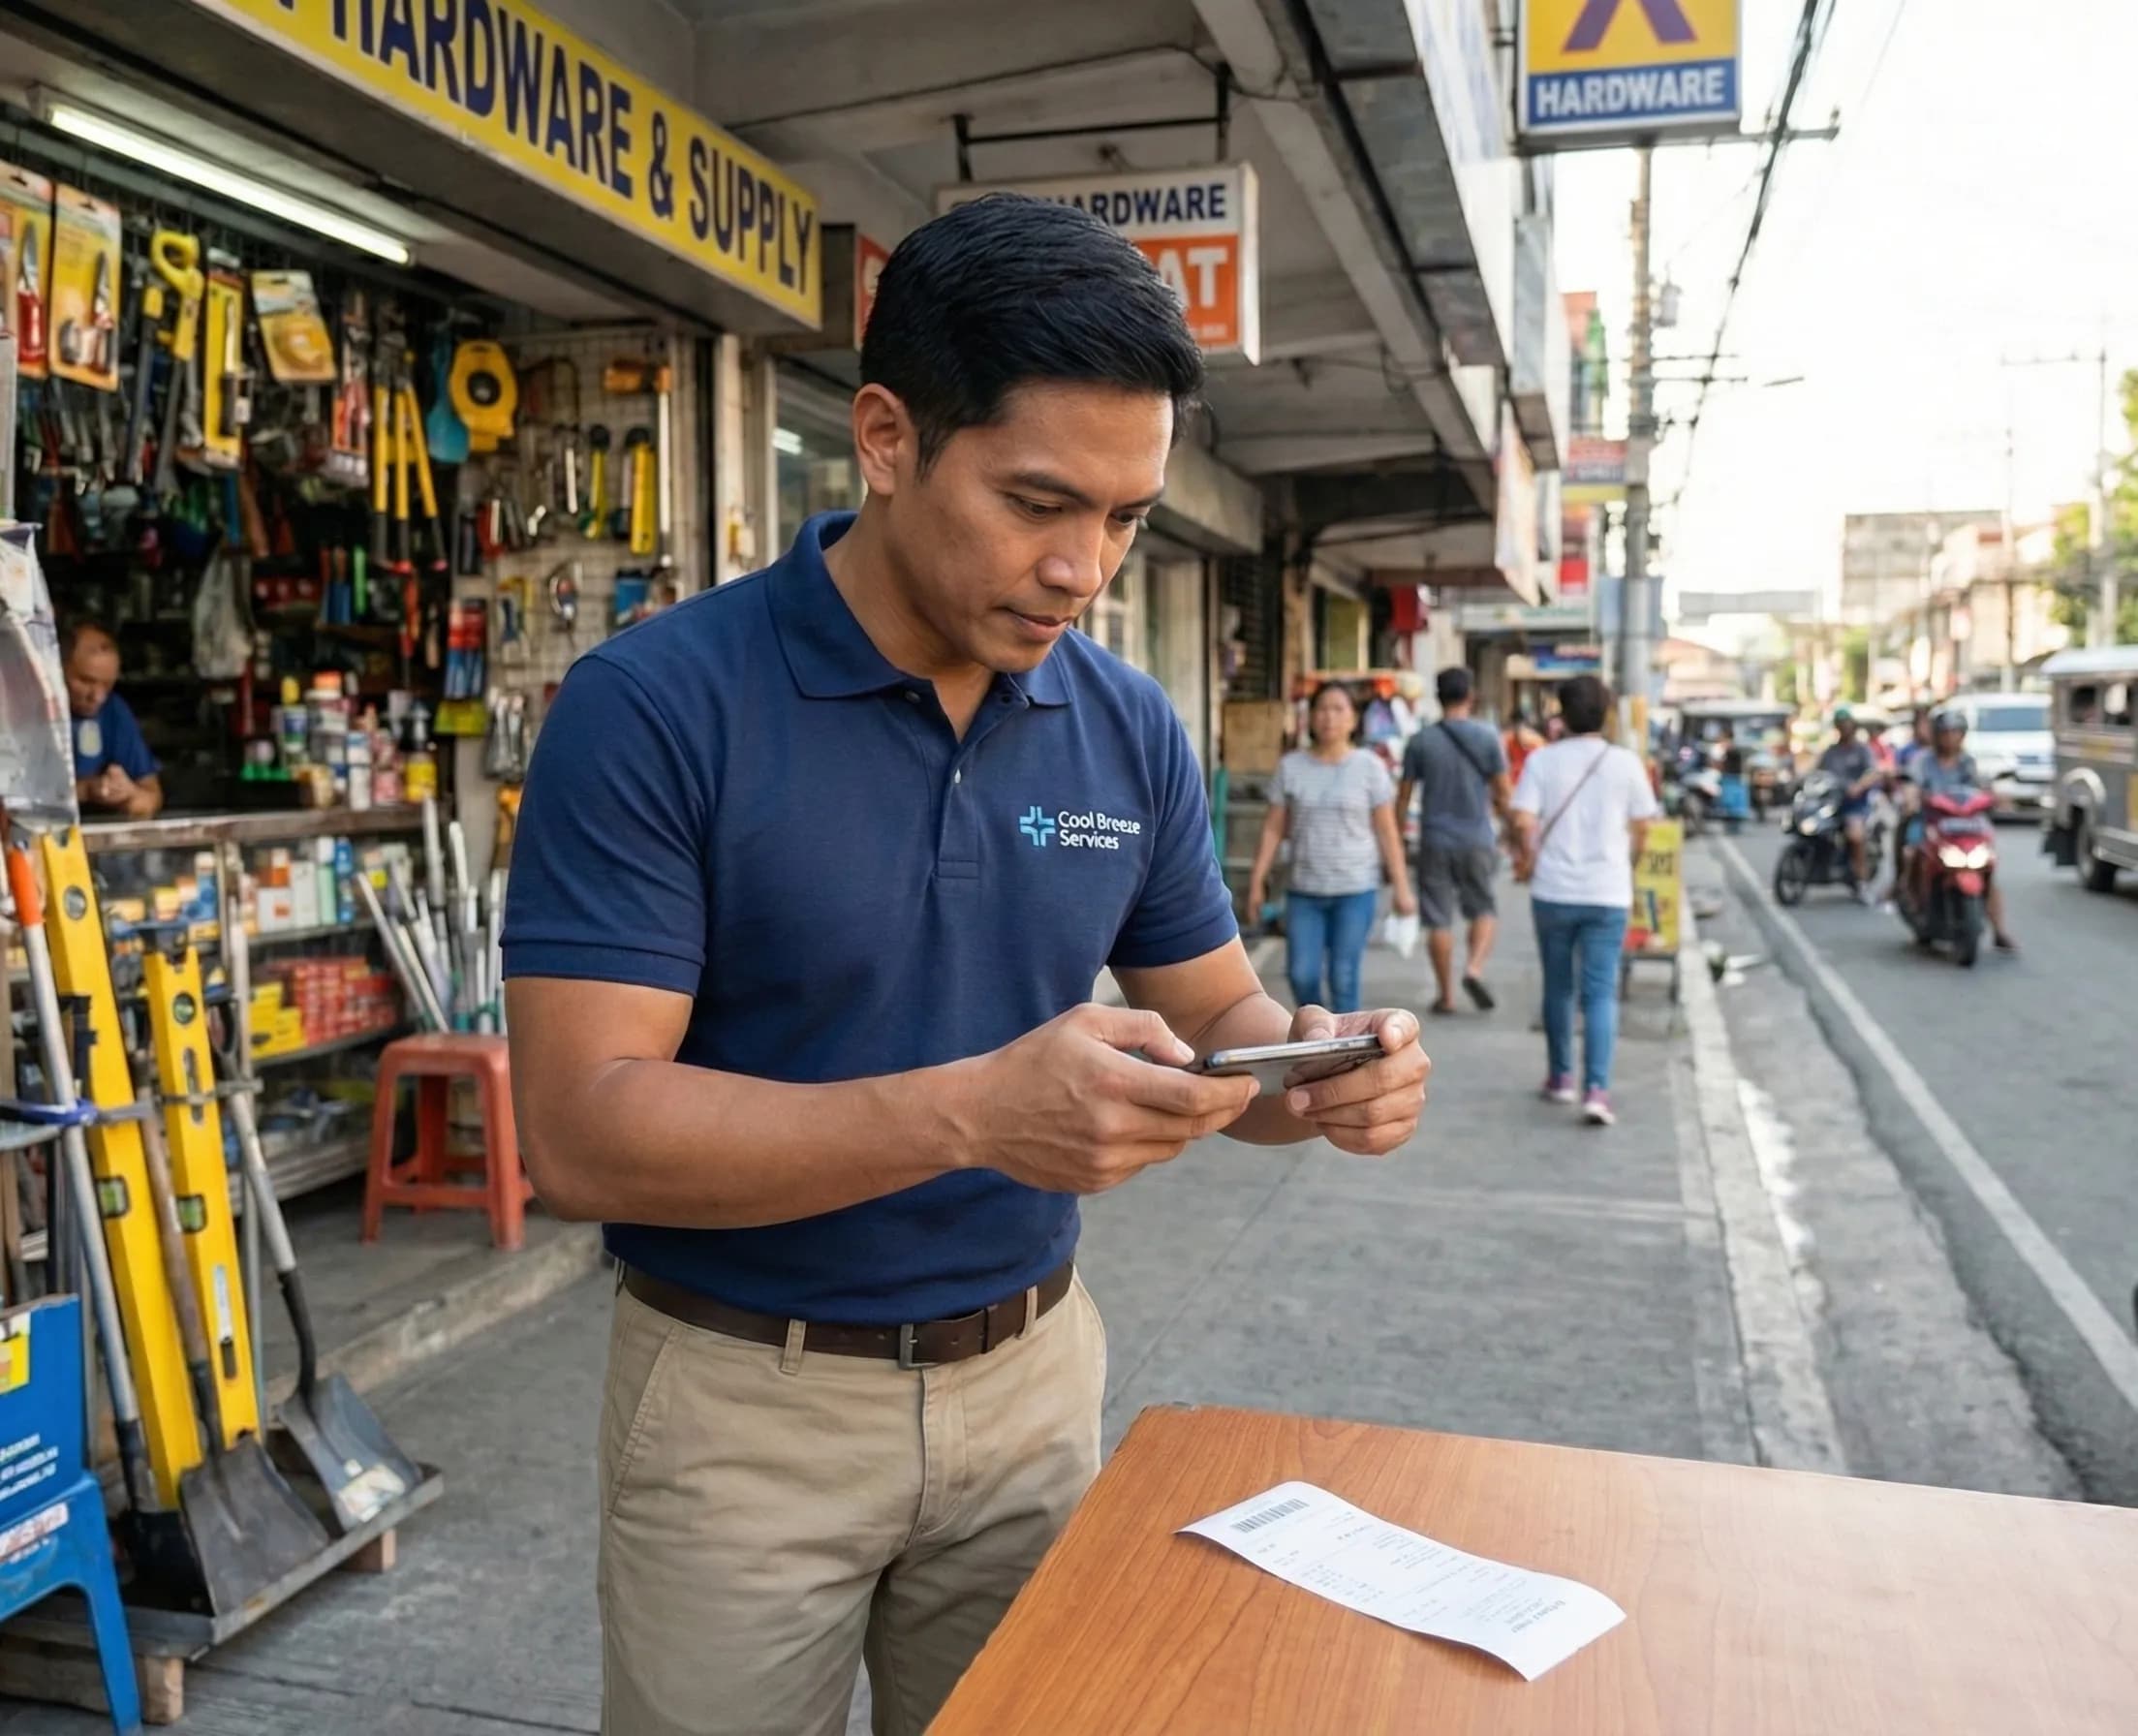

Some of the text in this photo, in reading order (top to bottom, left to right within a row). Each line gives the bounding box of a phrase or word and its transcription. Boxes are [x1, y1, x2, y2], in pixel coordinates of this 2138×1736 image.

[1535, 66, 1724, 118] HARDWARE
[648, 110, 673, 222] &
[689, 136, 813, 295] SUPPLY
[1046, 184, 1225, 225] RDWARE
[1058, 811, 1141, 835] Cool Breeze
[1060, 829, 1120, 850] Services
